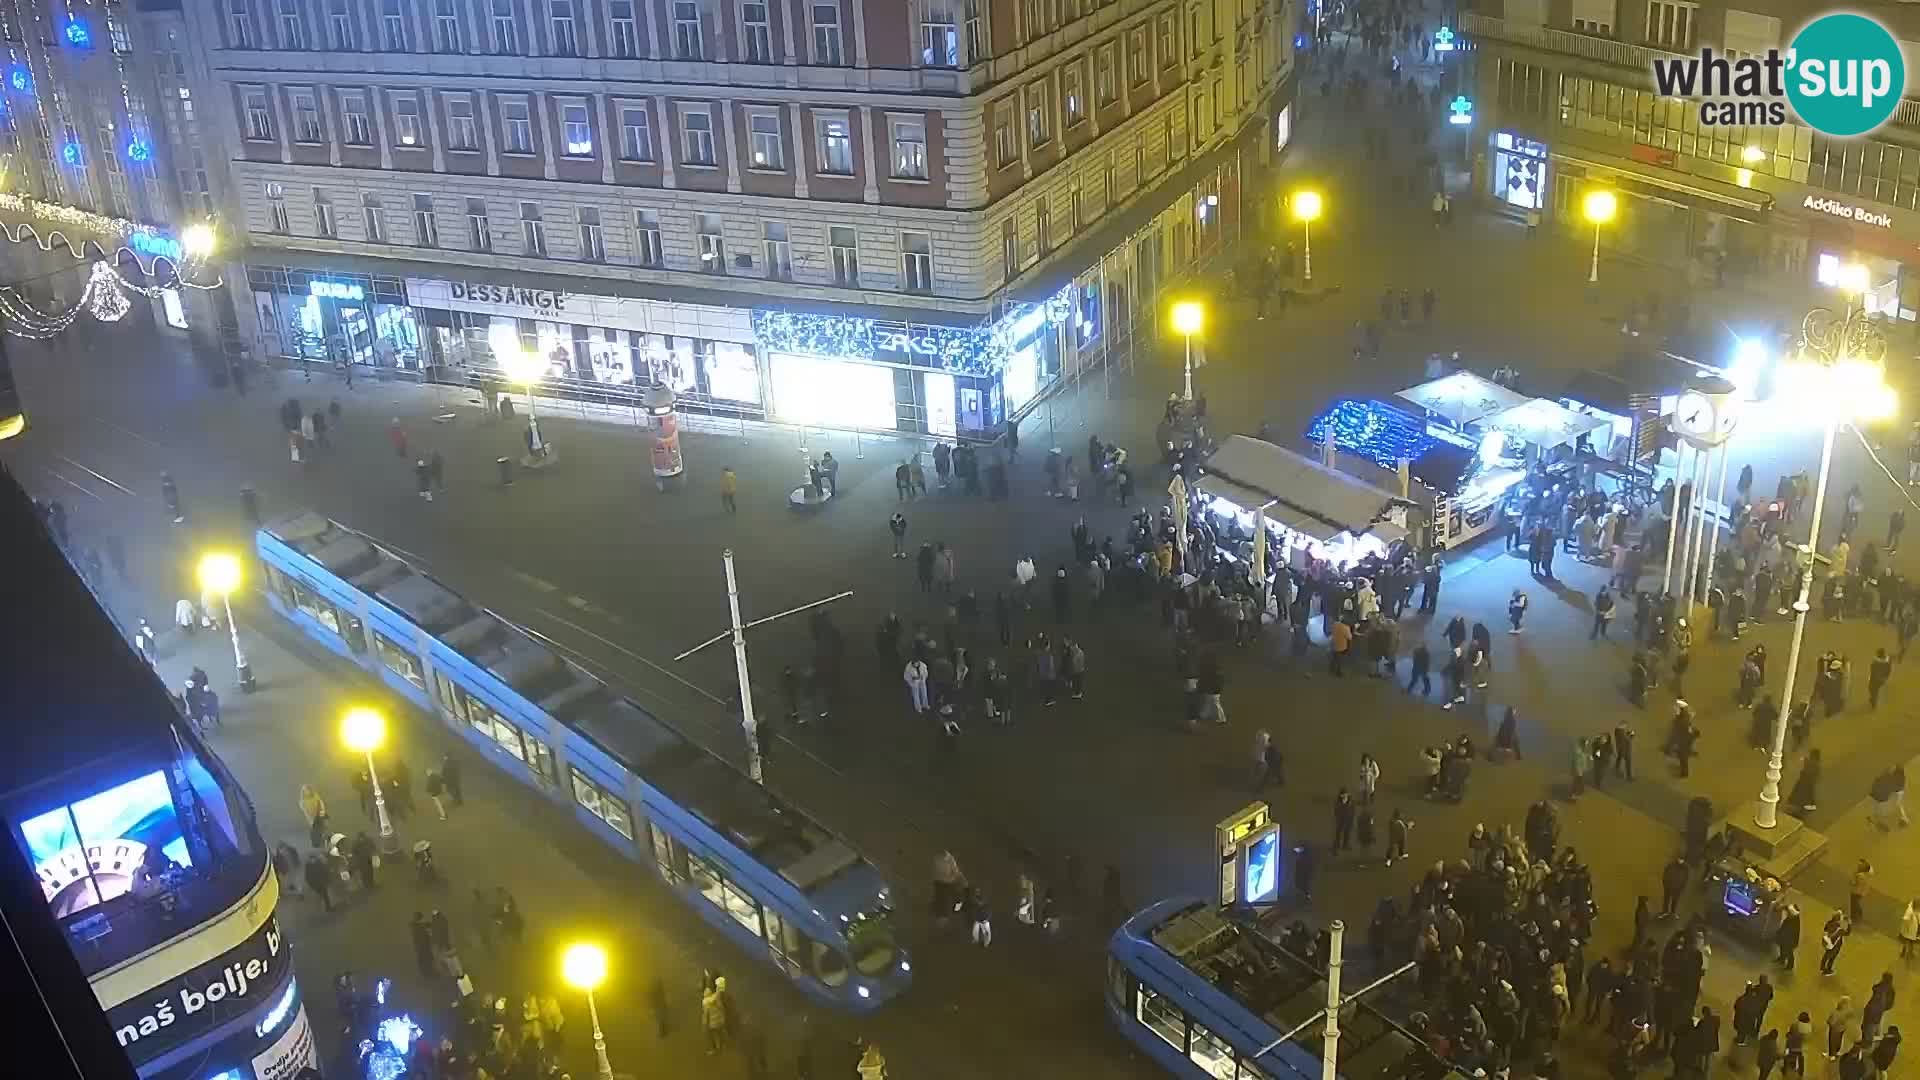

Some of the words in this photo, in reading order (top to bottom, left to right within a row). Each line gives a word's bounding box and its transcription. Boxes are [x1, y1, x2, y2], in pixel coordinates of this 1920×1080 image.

[1804, 195, 1853, 218] Addiko
[1854, 207, 1892, 229] Bank
[450, 282, 566, 310] DESSANGE
[876, 332, 938, 355] ZAKS
[180, 958, 268, 1015] bolje,
